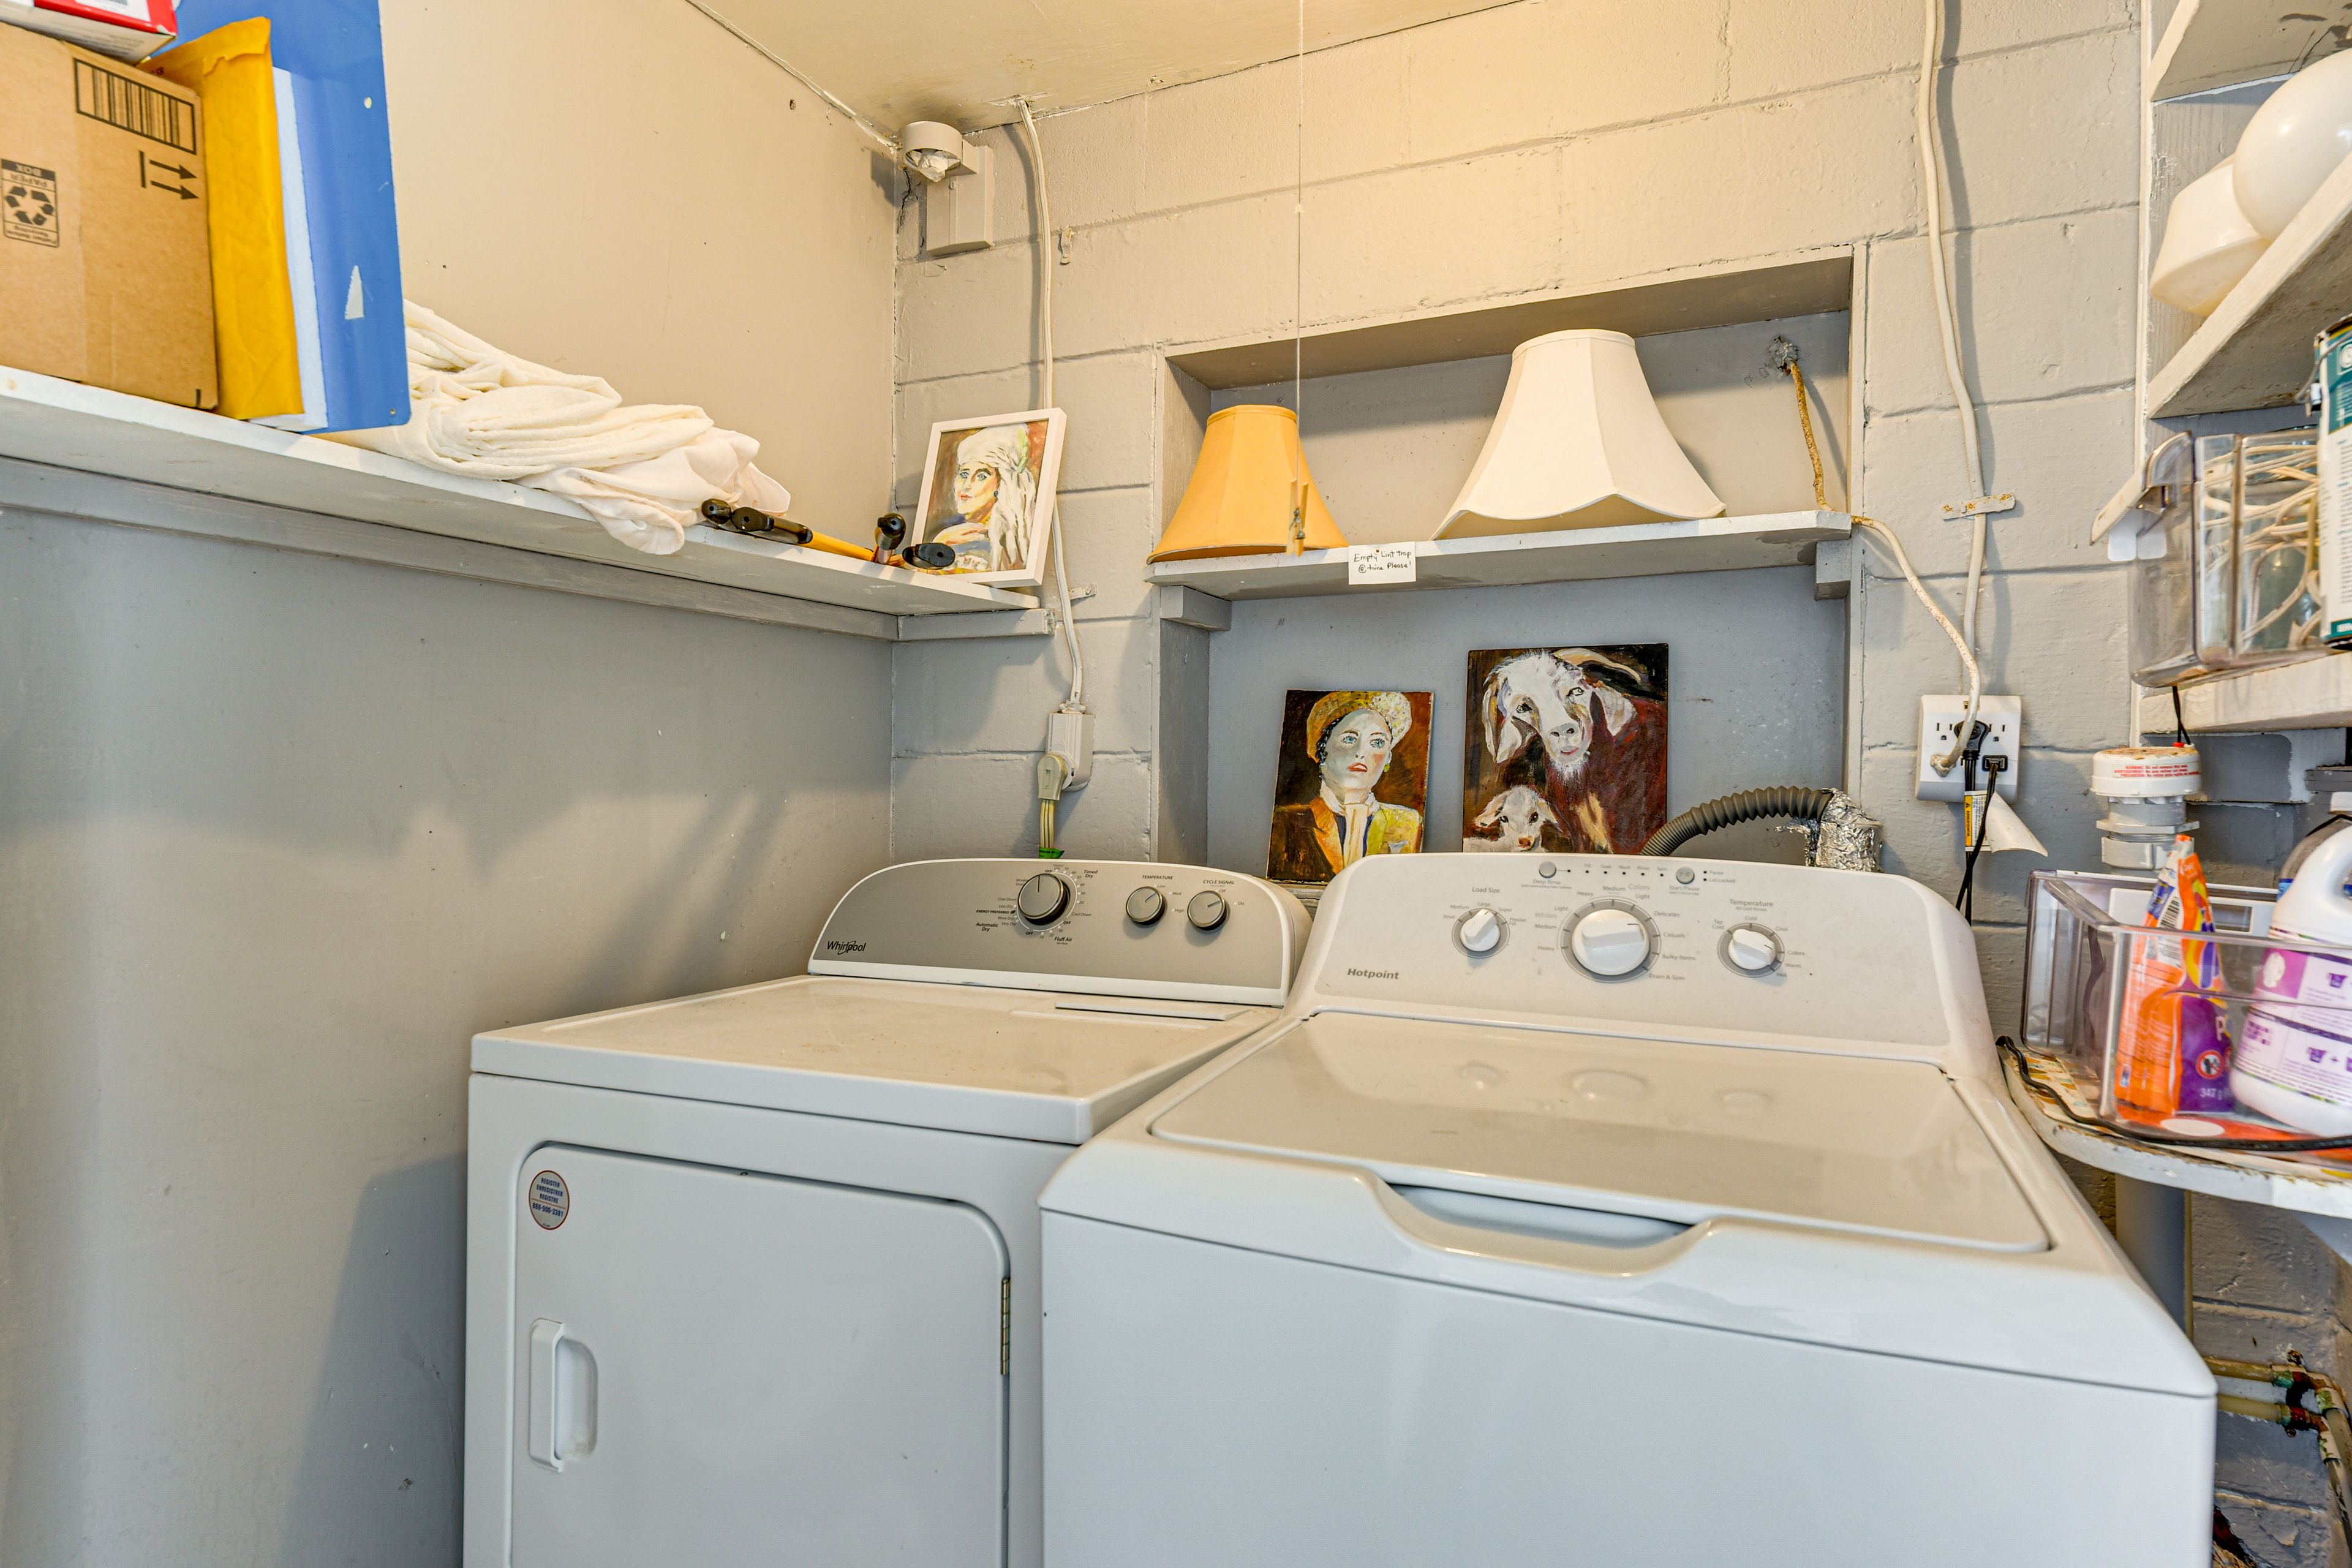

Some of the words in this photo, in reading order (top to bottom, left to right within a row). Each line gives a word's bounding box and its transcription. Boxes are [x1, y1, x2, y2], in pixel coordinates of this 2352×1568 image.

[16, 164, 41, 176] BOX
[10, 172, 47, 187] PAPER
[1354, 553, 1378, 562] Empty
[827, 940, 867, 955] Whirlpool
[1348, 968, 1399, 979] Hotpoint
[541, 1178, 560, 1188] REGISTER
